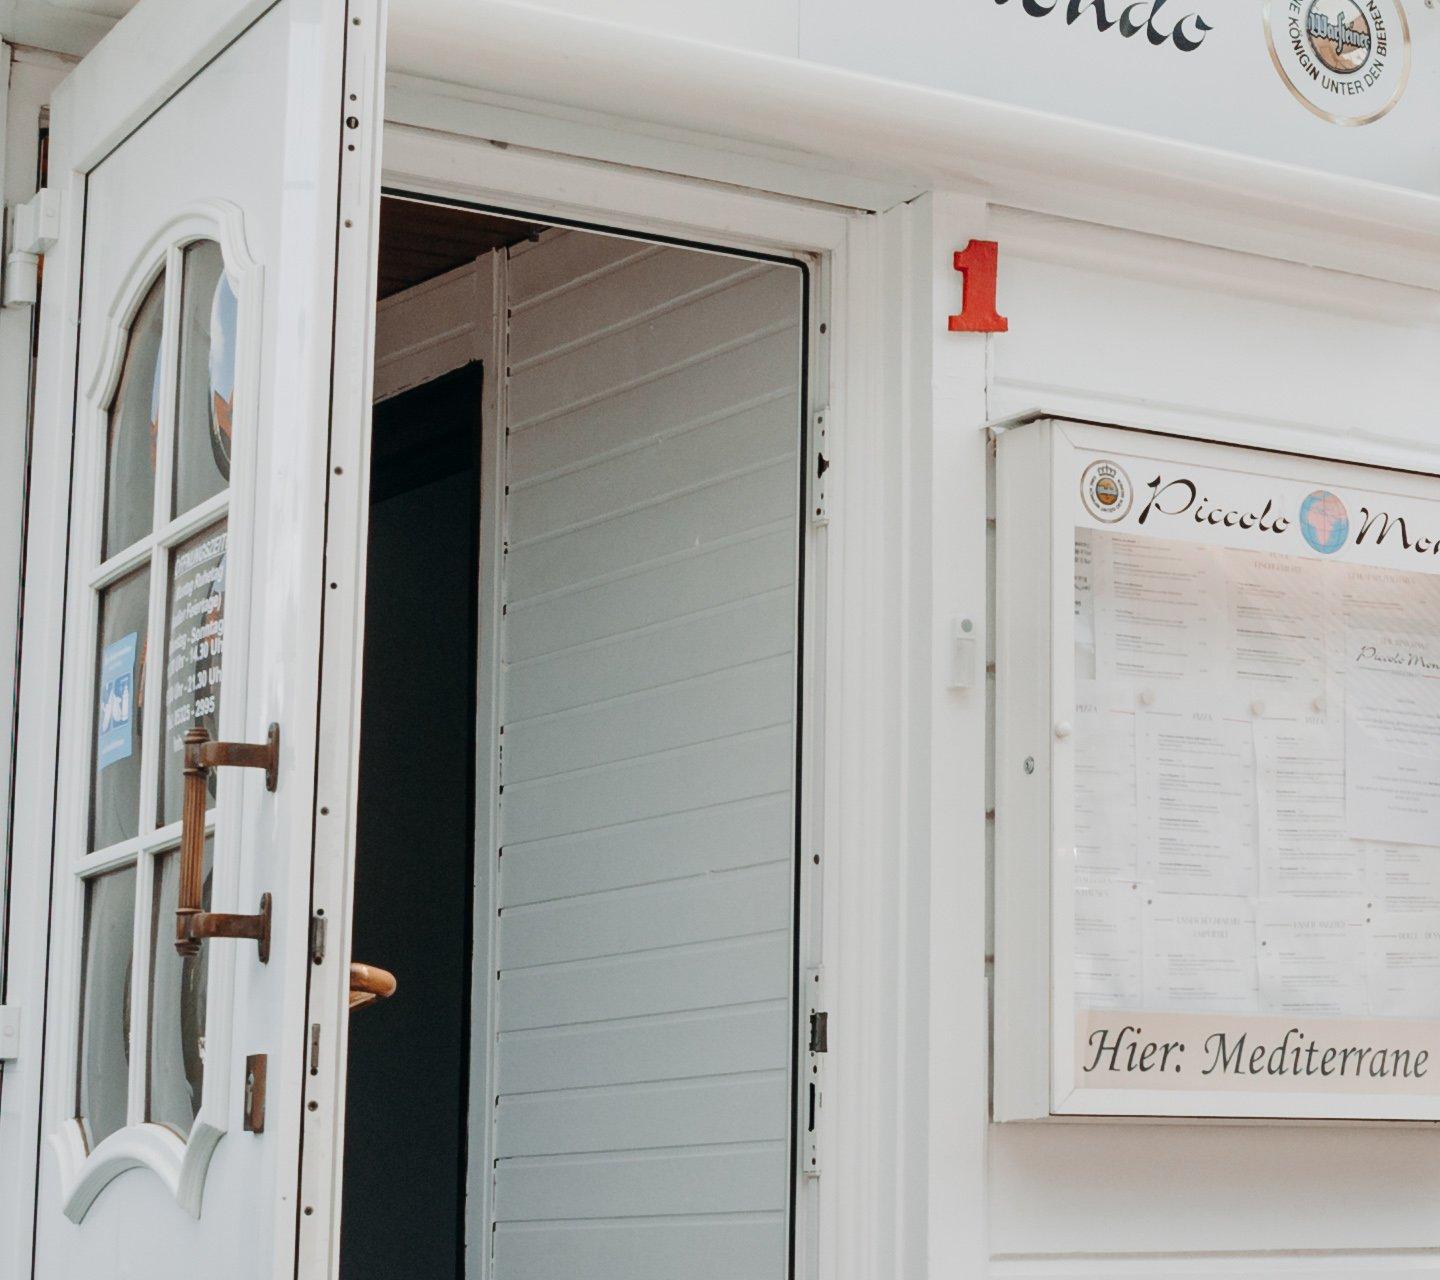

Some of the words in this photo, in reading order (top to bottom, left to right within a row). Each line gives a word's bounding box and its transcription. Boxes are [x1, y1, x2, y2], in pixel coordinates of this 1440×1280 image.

[1288, 16, 1320, 81] KÖNIGIN
[1321, 73, 1365, 96] UNTER
[1365, 59, 1385, 88] DEN
[1137, 475, 1291, 535] Piccolo
[1082, 1025, 1186, 1074] Hier:
[1201, 1028, 1429, 1080] Mediterrane
